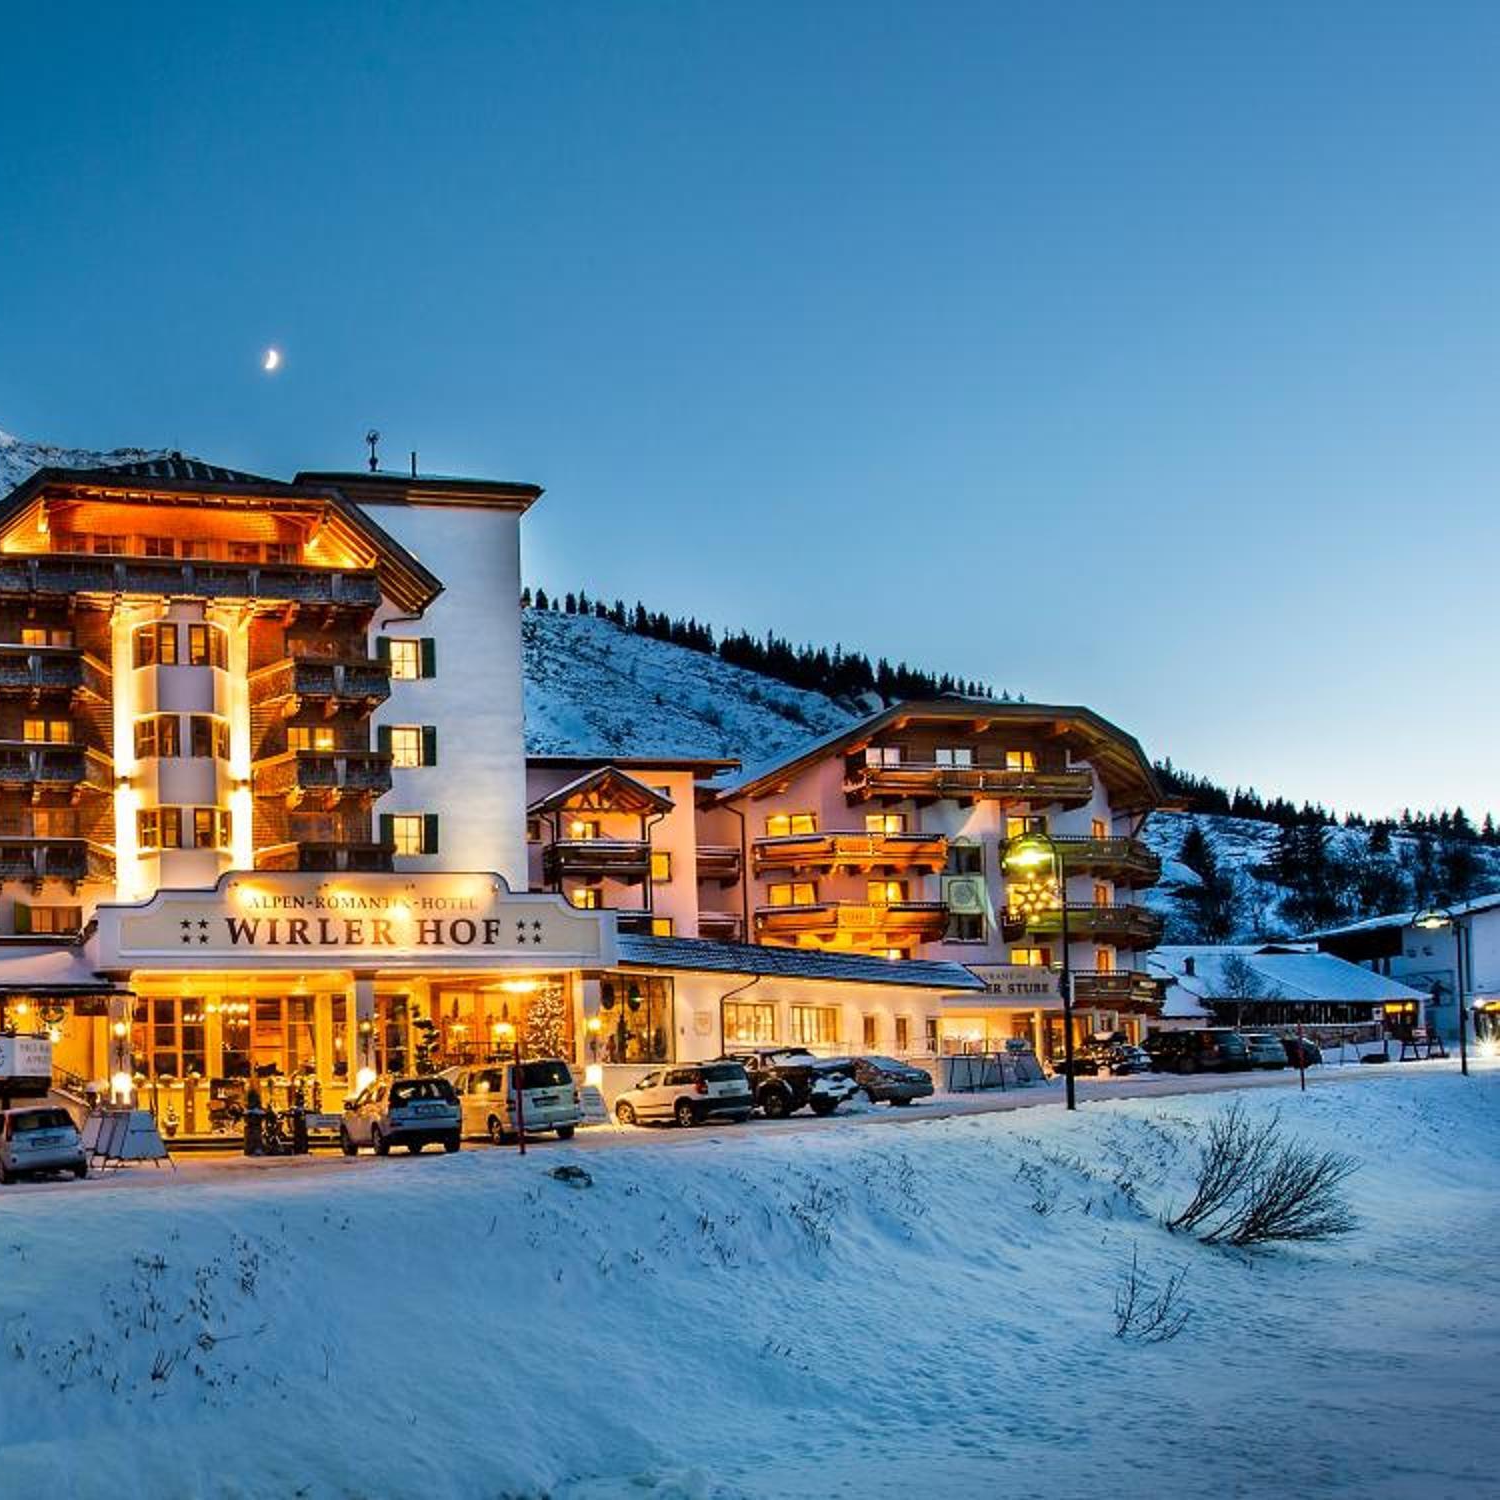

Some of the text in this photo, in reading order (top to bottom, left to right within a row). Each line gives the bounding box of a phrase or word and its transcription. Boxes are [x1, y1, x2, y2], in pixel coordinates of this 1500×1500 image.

[225, 917, 501, 945] WIRLER HOF
[1007, 983, 1049, 993] STUBE
